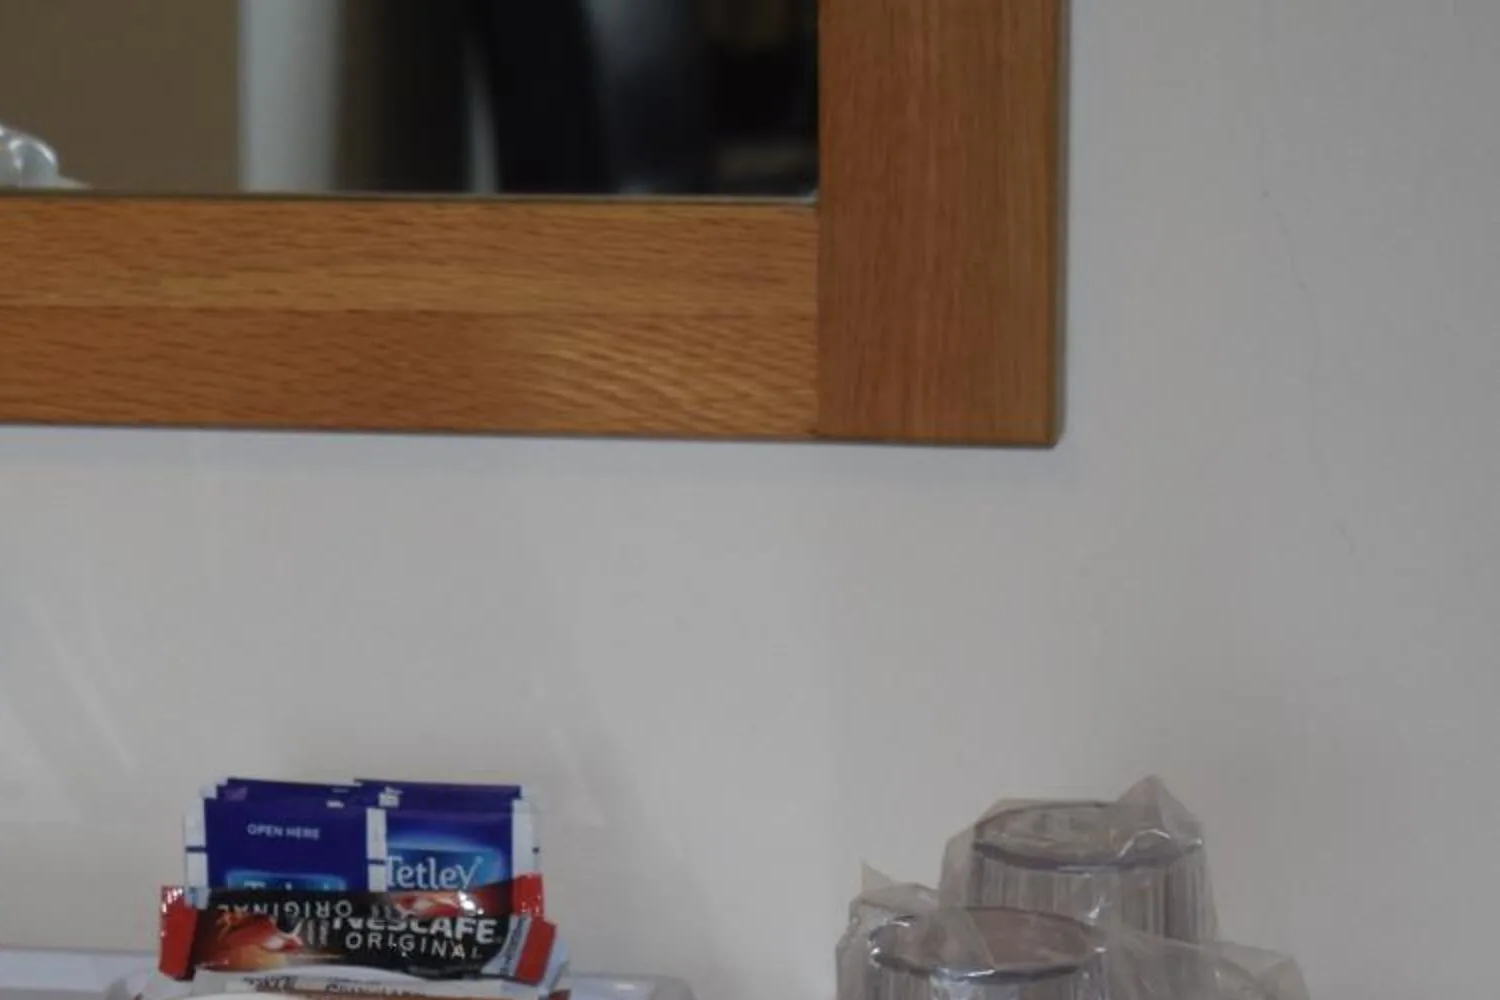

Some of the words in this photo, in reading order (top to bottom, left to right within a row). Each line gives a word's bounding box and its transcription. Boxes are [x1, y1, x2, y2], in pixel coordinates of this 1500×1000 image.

[247, 823, 283, 838] OPEN
[285, 825, 320, 840] HERE
[386, 855, 476, 890] Tetley
[345, 931, 480, 959] ORIGINAL
